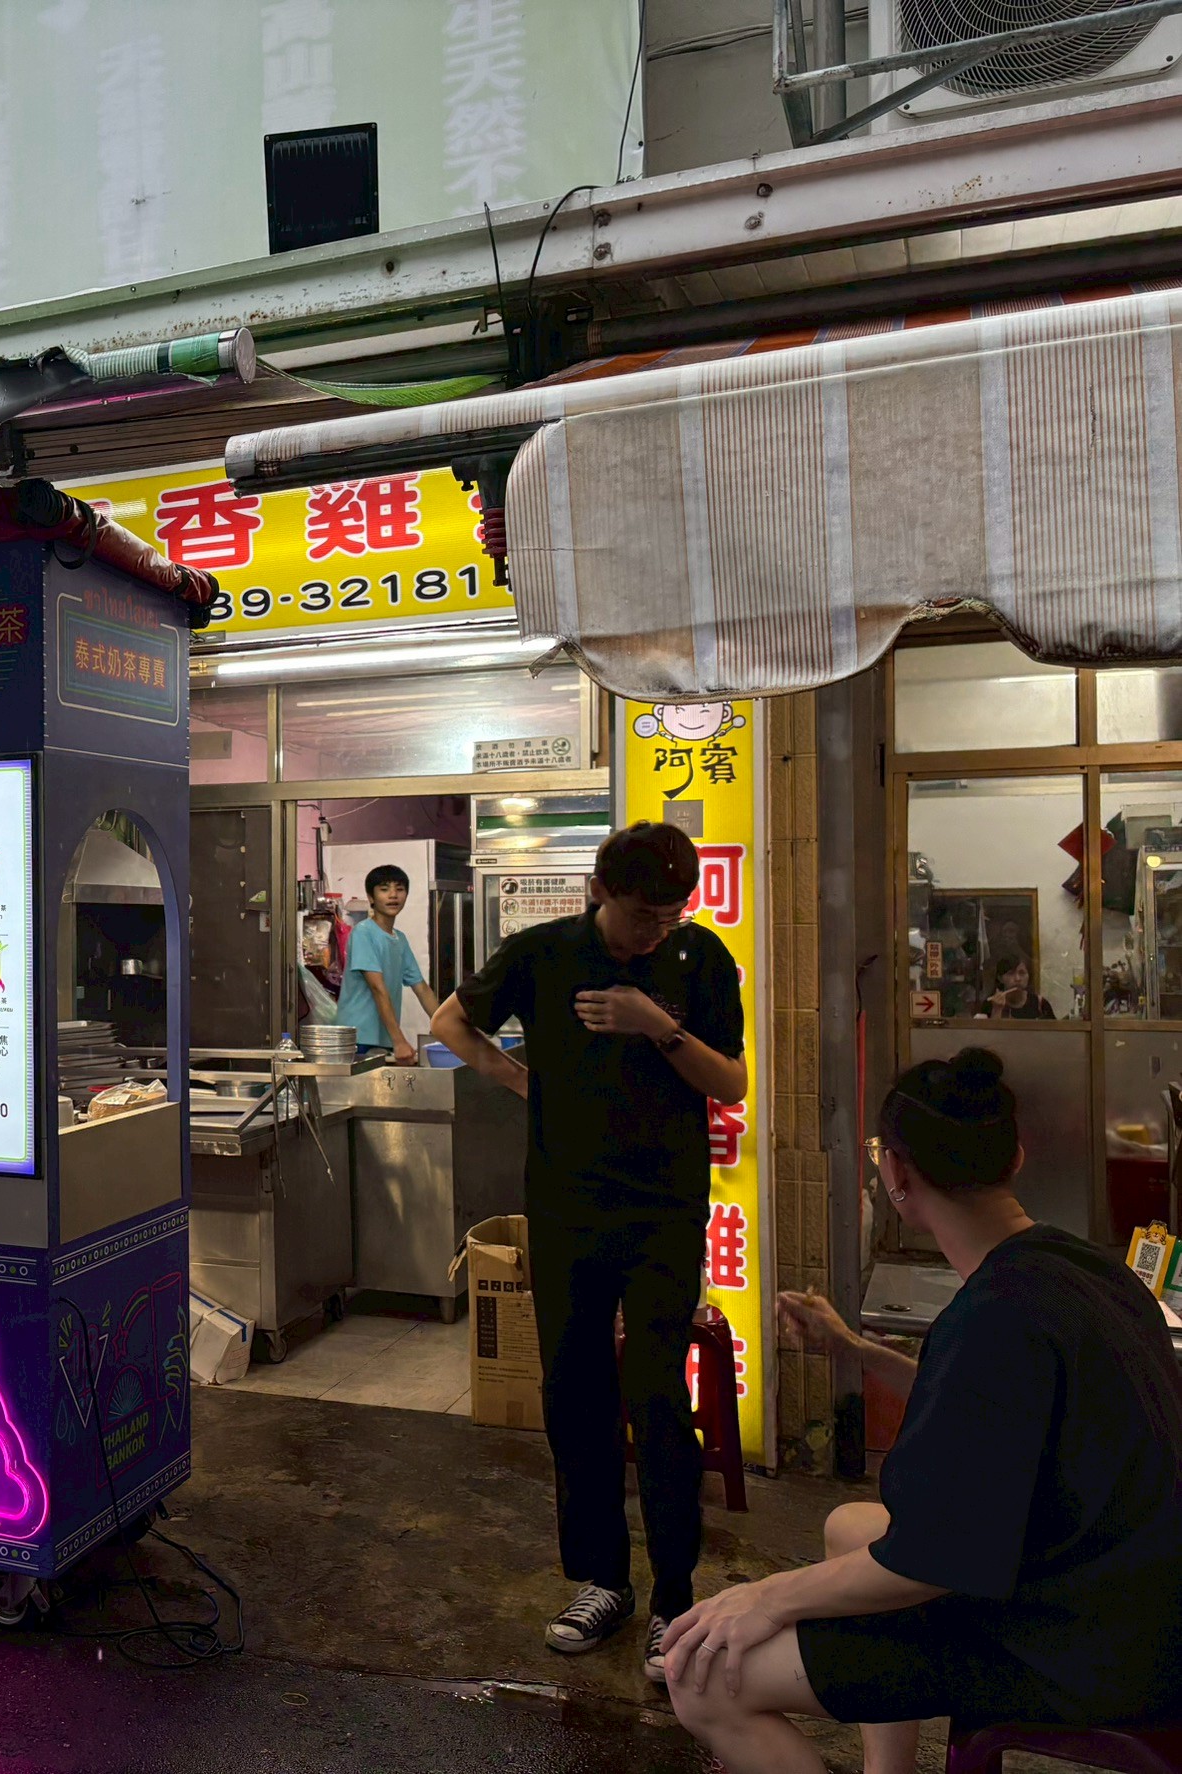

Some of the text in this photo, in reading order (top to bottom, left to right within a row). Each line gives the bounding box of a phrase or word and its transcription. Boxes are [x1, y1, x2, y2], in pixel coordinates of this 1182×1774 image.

[92, 474, 486, 572] 香雞
[209, 566, 514, 621] 89-32181
[75, 638, 167, 689] 泰式奶茶專賣
[653, 743, 738, 800] 阿賓
[103, 1411, 149, 1450] THAILAND
